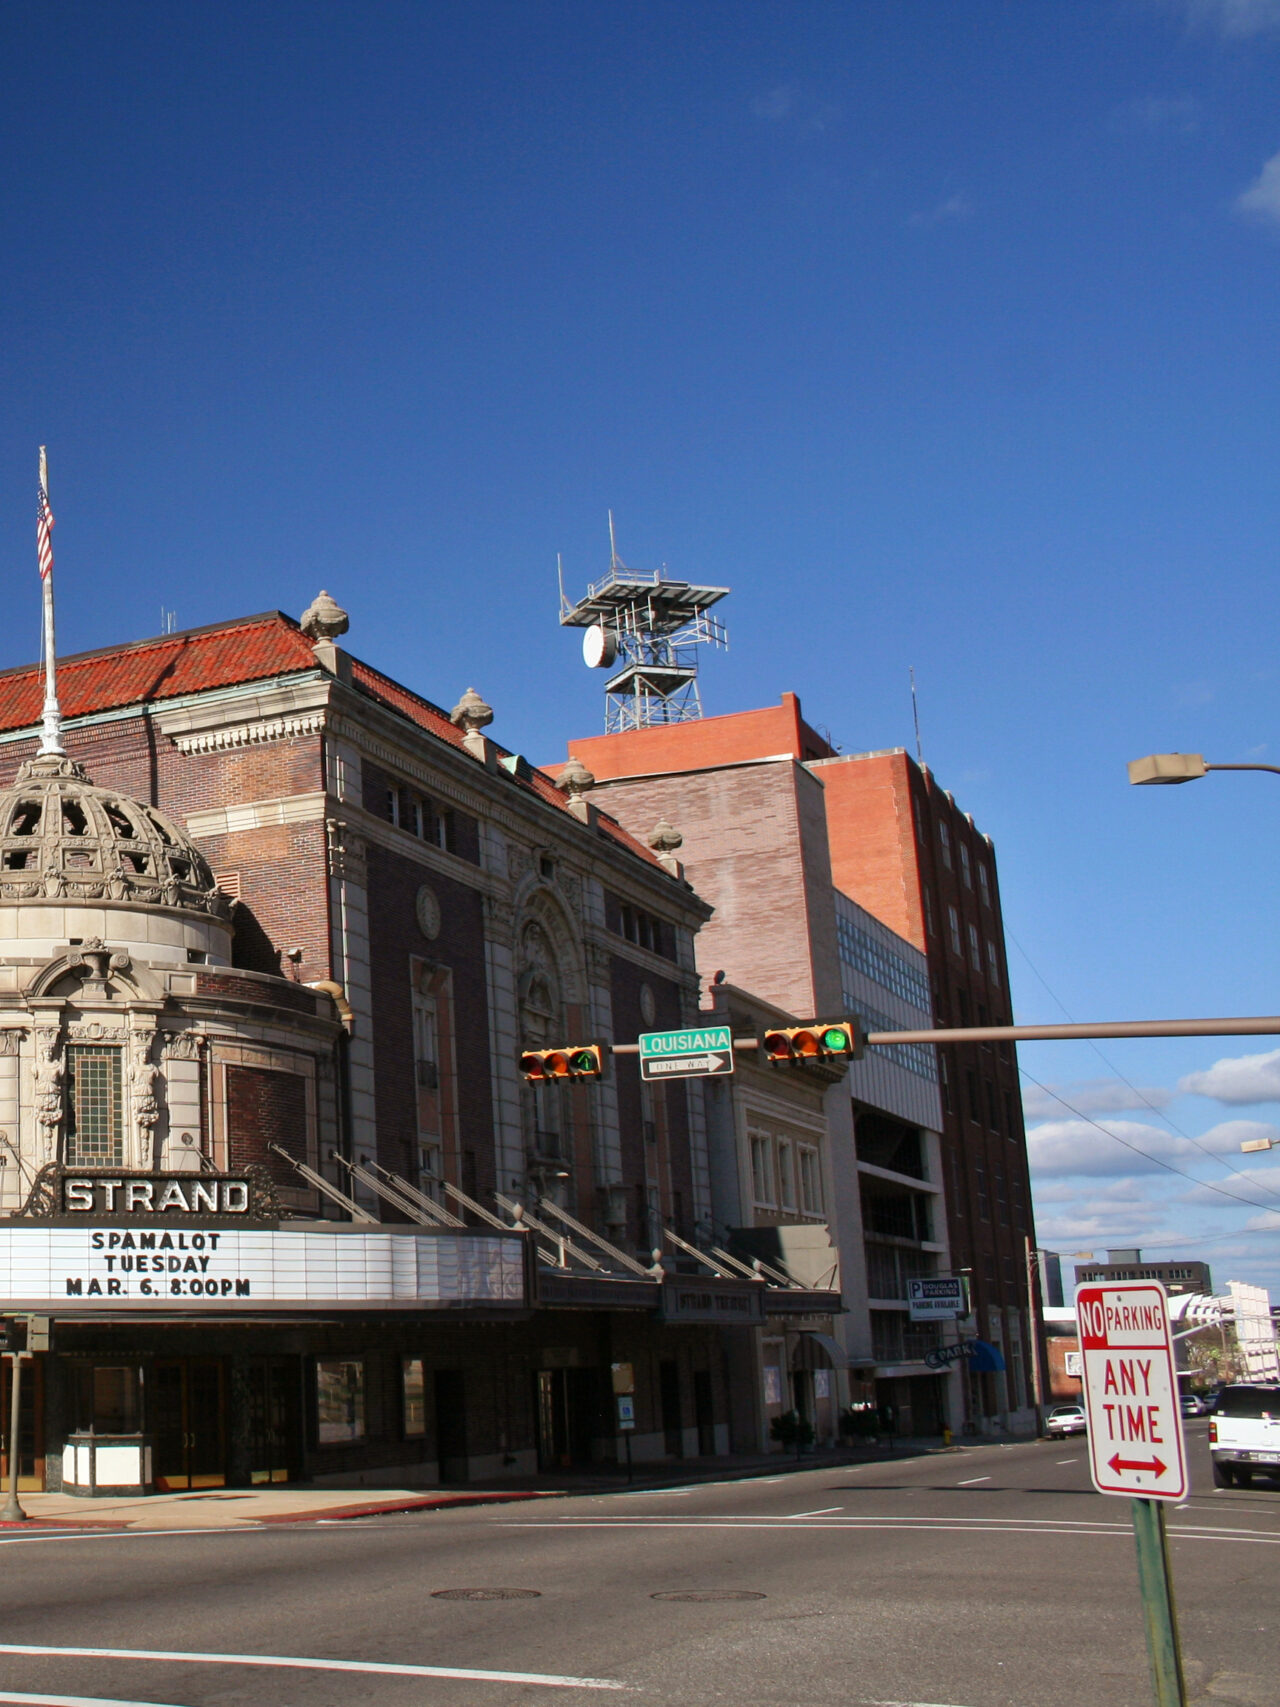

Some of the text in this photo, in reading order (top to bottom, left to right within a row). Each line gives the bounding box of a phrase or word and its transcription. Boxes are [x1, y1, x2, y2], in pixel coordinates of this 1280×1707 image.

[642, 1031, 729, 1053] LOUISIANA
[656, 1060, 710, 1071] ONE WAY
[65, 1179, 248, 1213] STRAND
[92, 1232, 220, 1250] SPAMALOT
[104, 1255, 210, 1273] TUESDAY
[66, 1278, 250, 1296] MAR. 6, 8:00PM
[1080, 1301, 1162, 1338] NO PARKING
[1104, 1359, 1152, 1396] ANY
[1103, 1404, 1163, 1444] TIME
